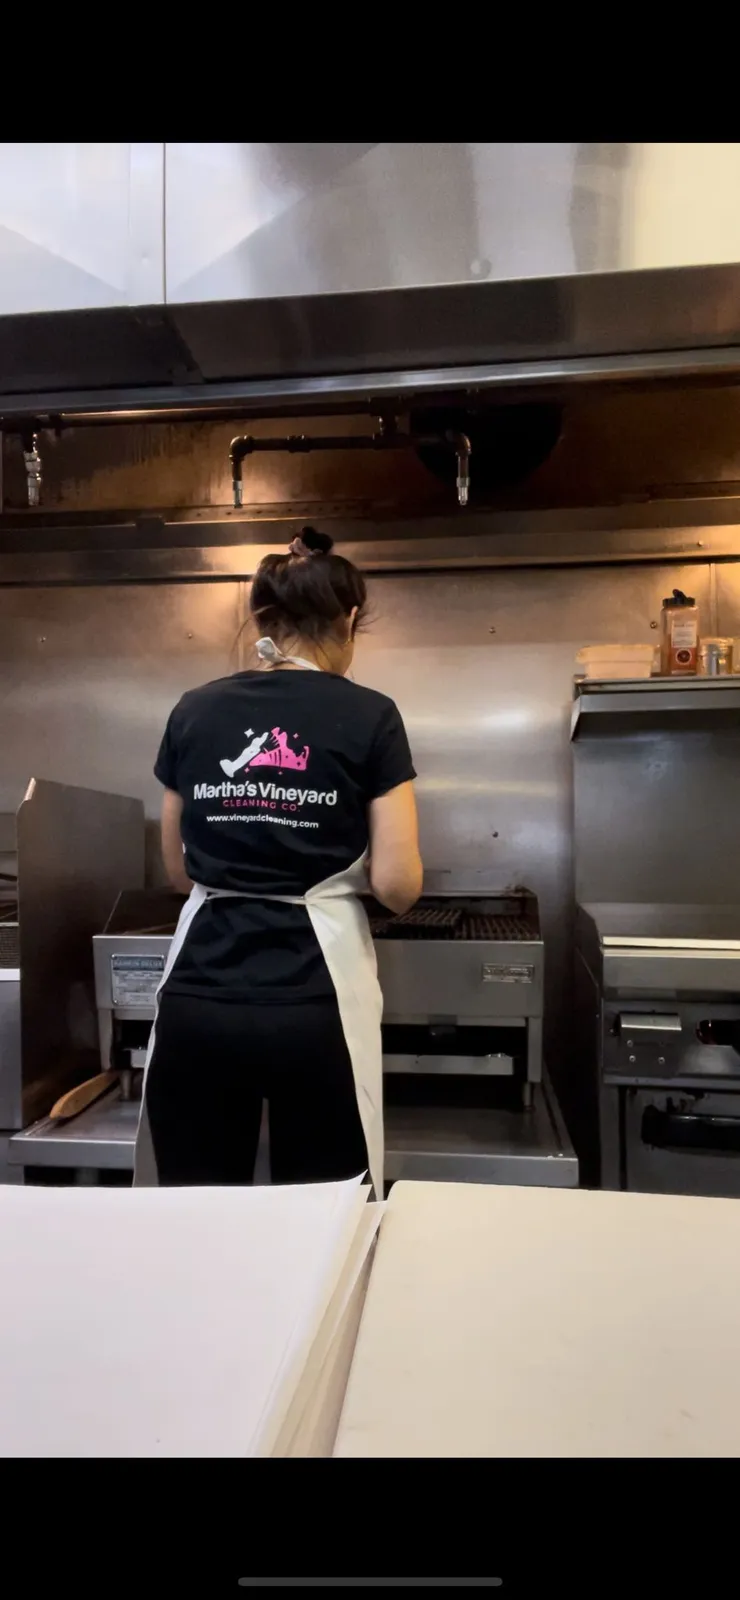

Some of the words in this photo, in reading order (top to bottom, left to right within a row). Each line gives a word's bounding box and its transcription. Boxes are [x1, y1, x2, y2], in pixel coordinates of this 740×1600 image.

[193, 781, 257, 800] Martha's
[258, 782, 338, 806] Vineyard
[222, 799, 276, 809] CLEANING
[206, 814, 319, 828] www.vineyardcleaning.com
